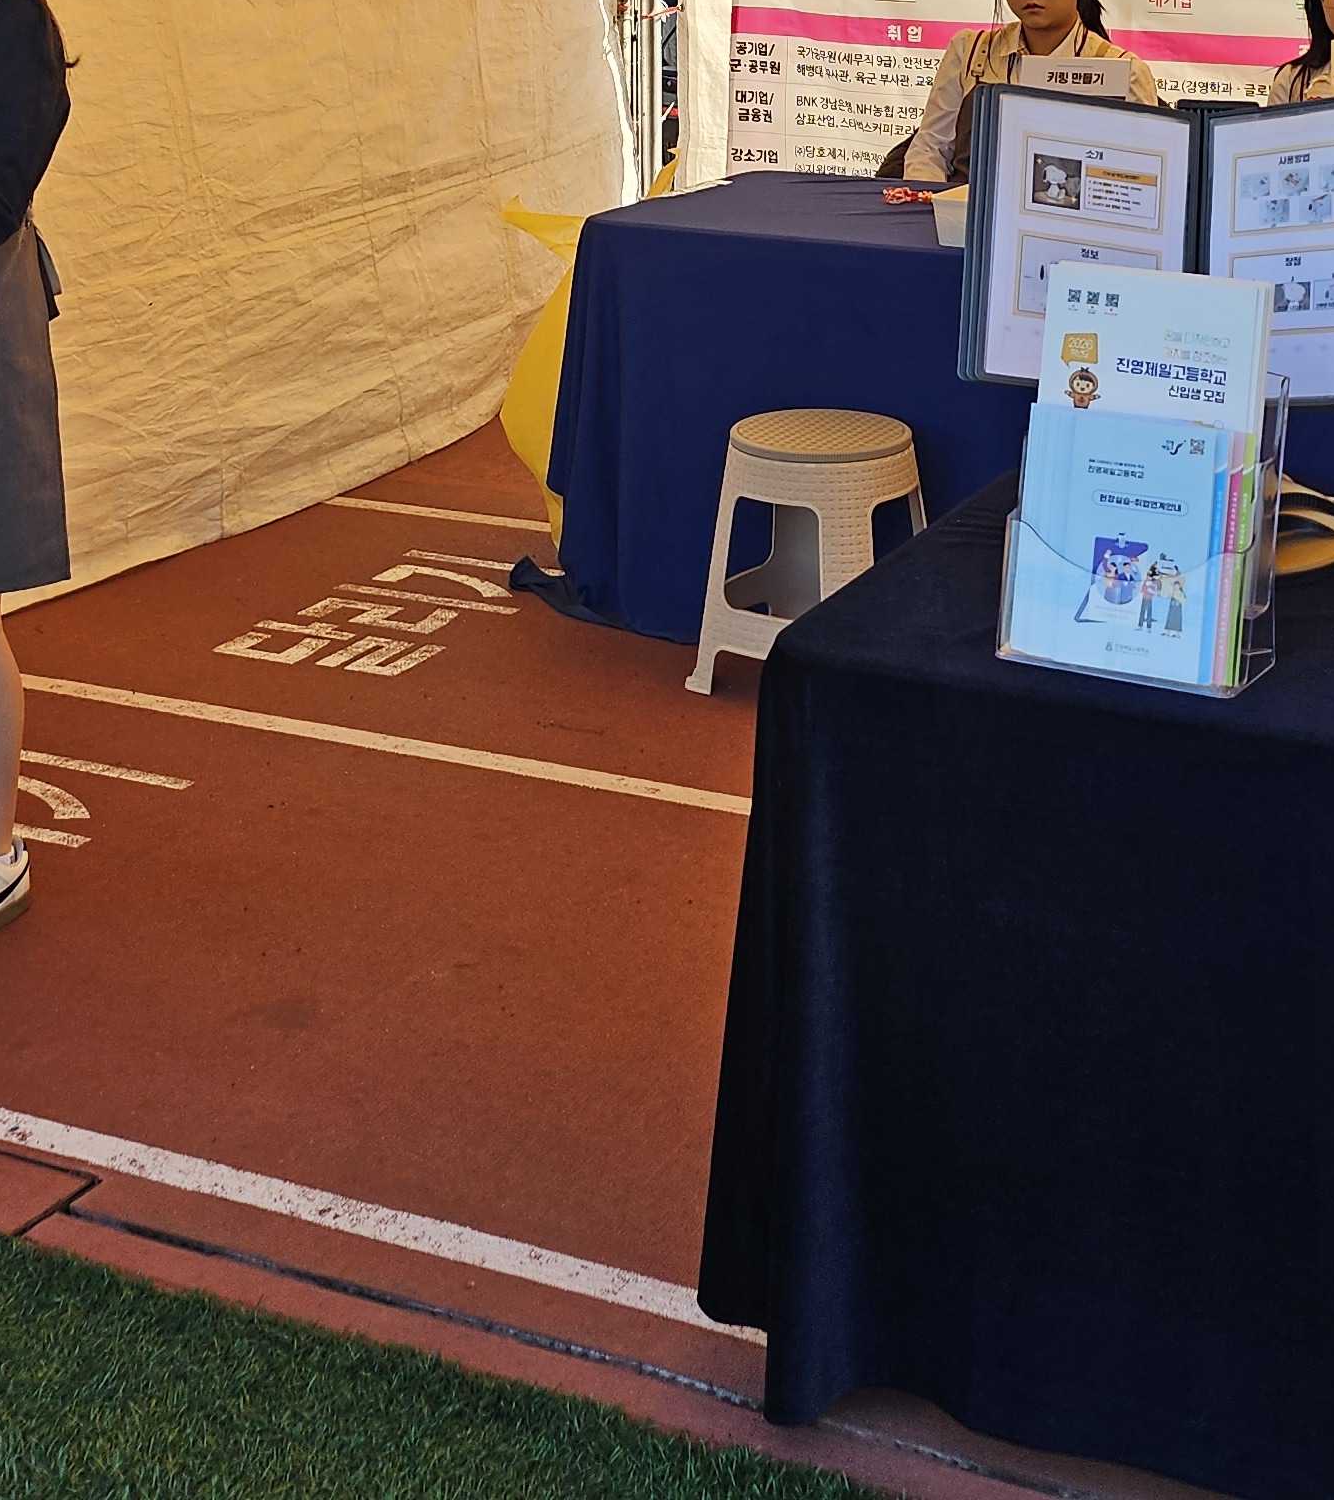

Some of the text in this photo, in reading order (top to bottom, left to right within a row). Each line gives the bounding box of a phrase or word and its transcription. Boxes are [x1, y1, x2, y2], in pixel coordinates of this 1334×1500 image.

[887, 25, 923, 43] 취업
[735, 41, 775, 57] 공기업/
[1046, 71, 1105, 86] 키링 만들기
[735, 90, 774, 106] 대기업/
[796, 95, 818, 108] BNK
[737, 107, 773, 123] 금융권
[730, 147, 779, 164] 강소기업
[1085, 149, 1104, 160] 소개
[1116, 357, 1227, 387] 진영제일고등학교
[1168, 384, 1226, 404] 신입생 모집
